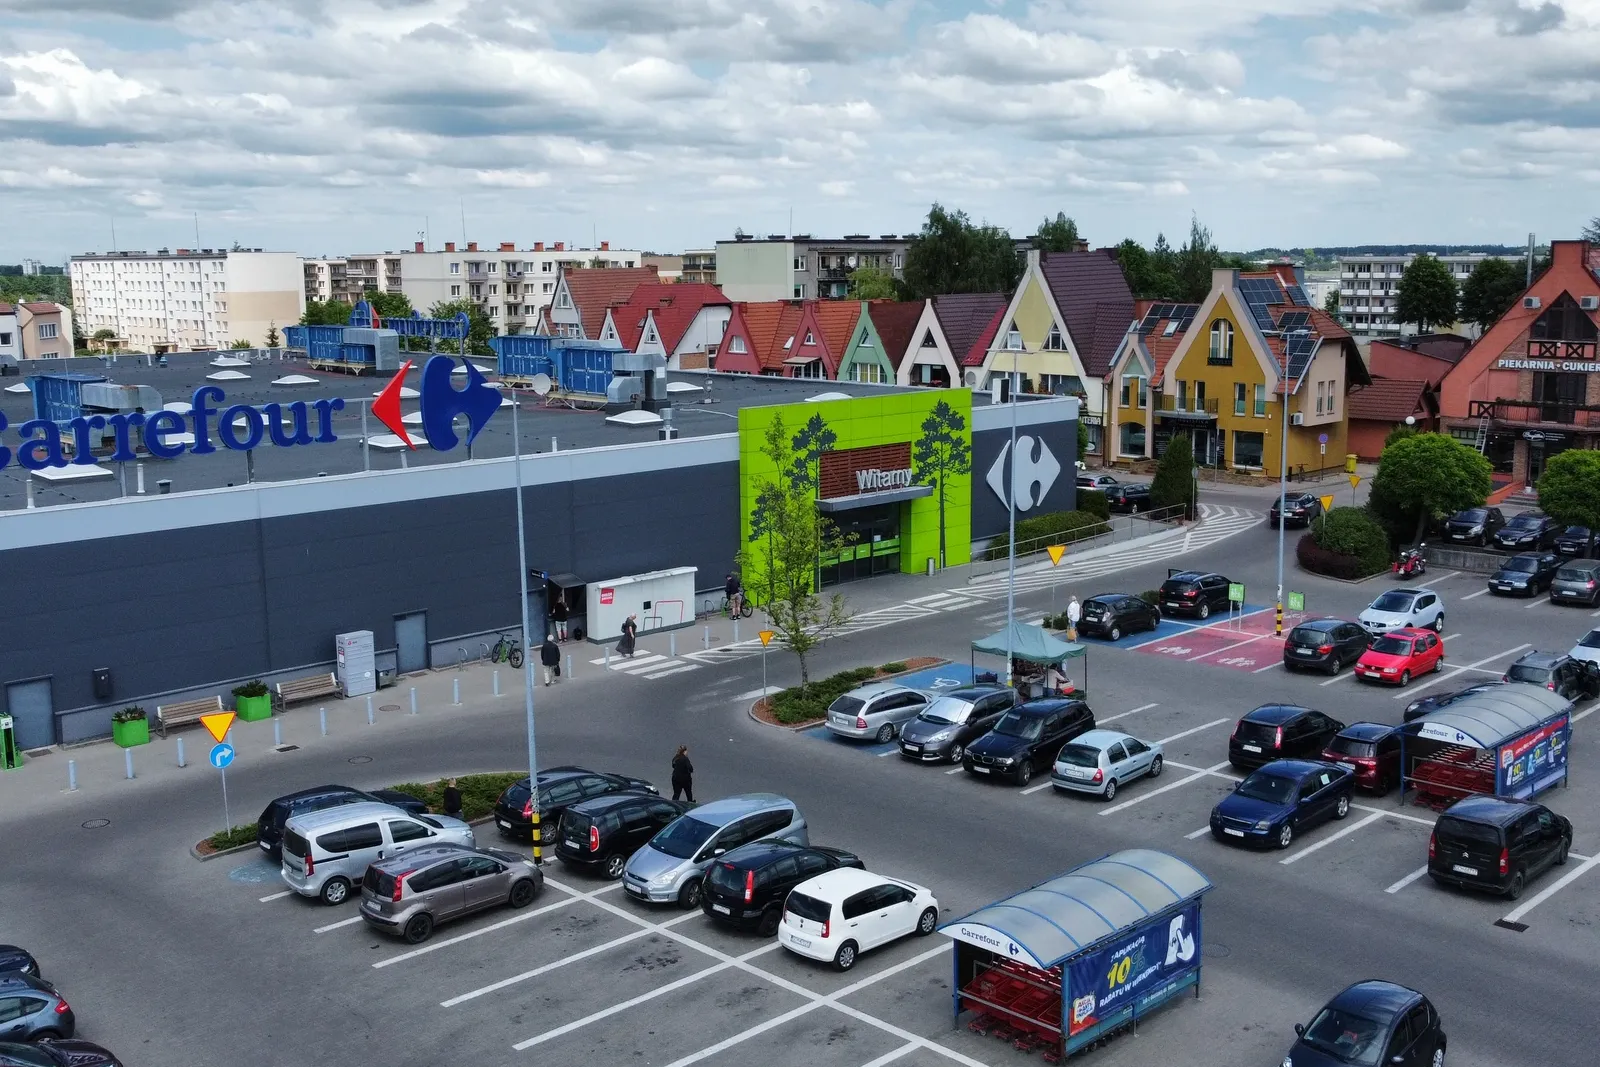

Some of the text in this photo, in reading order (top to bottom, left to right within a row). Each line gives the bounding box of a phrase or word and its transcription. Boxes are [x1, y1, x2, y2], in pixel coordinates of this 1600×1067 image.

[1498, 359, 1555, 370] PIEKARNIA
[0, 385, 345, 471] arrefour
[855, 468, 912, 490] Witamy
[961, 927, 1001, 947] Carrefour
[1099, 984, 1125, 1008] RABATU
